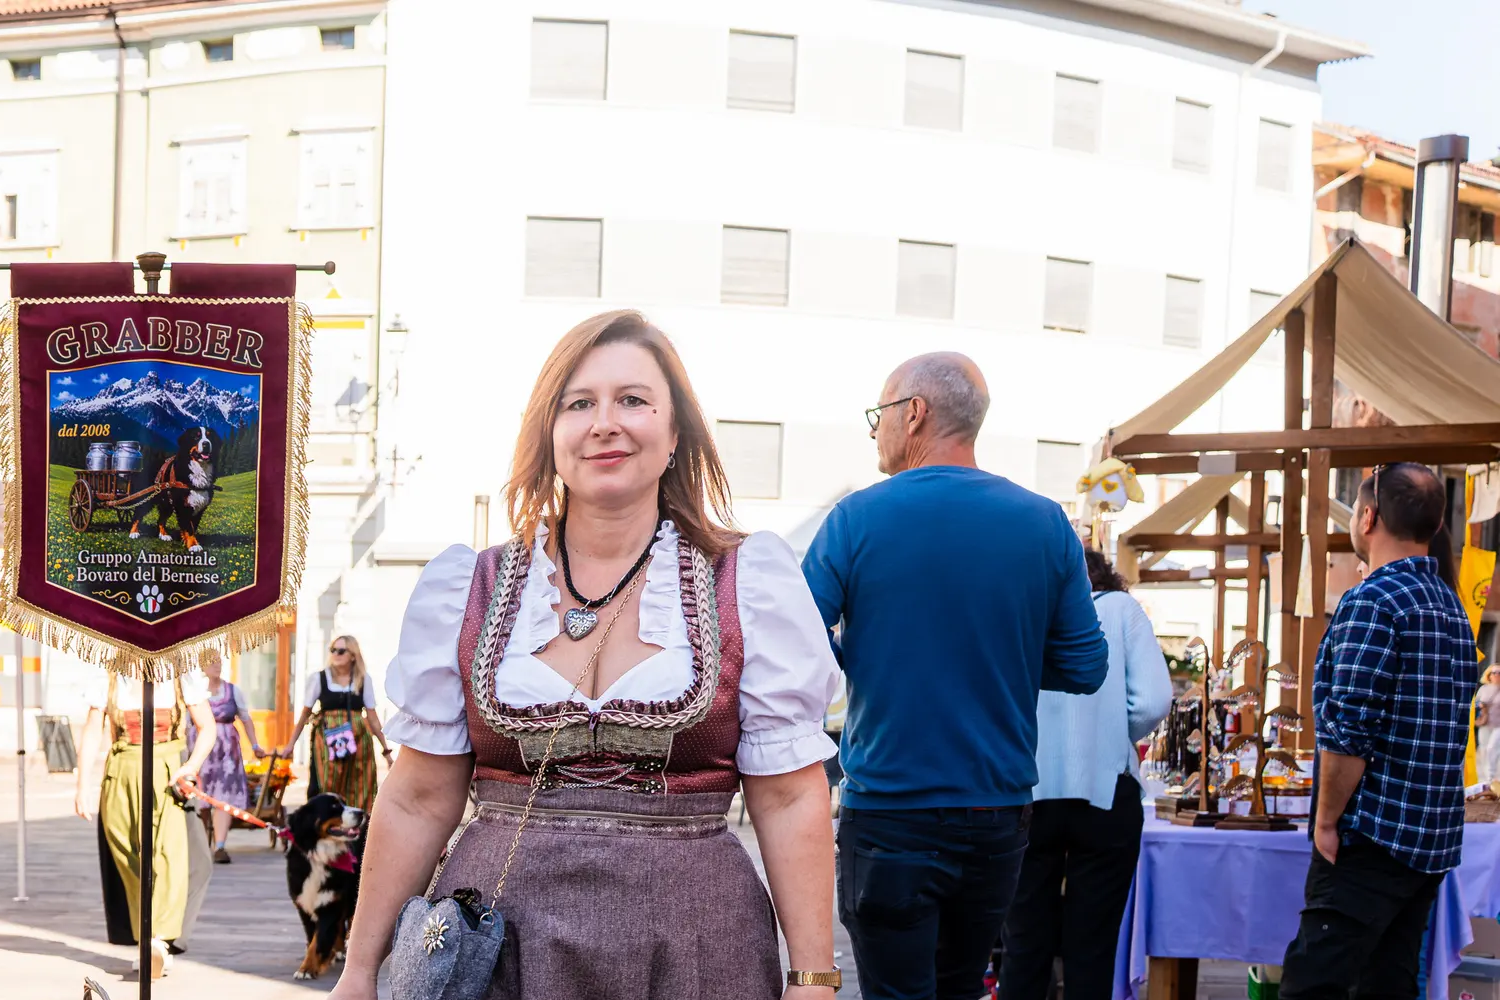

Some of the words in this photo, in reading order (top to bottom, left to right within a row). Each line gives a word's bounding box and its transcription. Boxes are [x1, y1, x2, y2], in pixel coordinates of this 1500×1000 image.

[47, 317, 263, 368] GRABBER
[58, 423, 78, 437] dal
[80, 423, 111, 437] 2008
[78, 549, 132, 567] Gruppo
[136, 549, 217, 566] Amatoriale
[76, 566, 128, 582] Bovaro
[132, 566, 156, 582] del
[160, 567, 219, 584] Bernese
